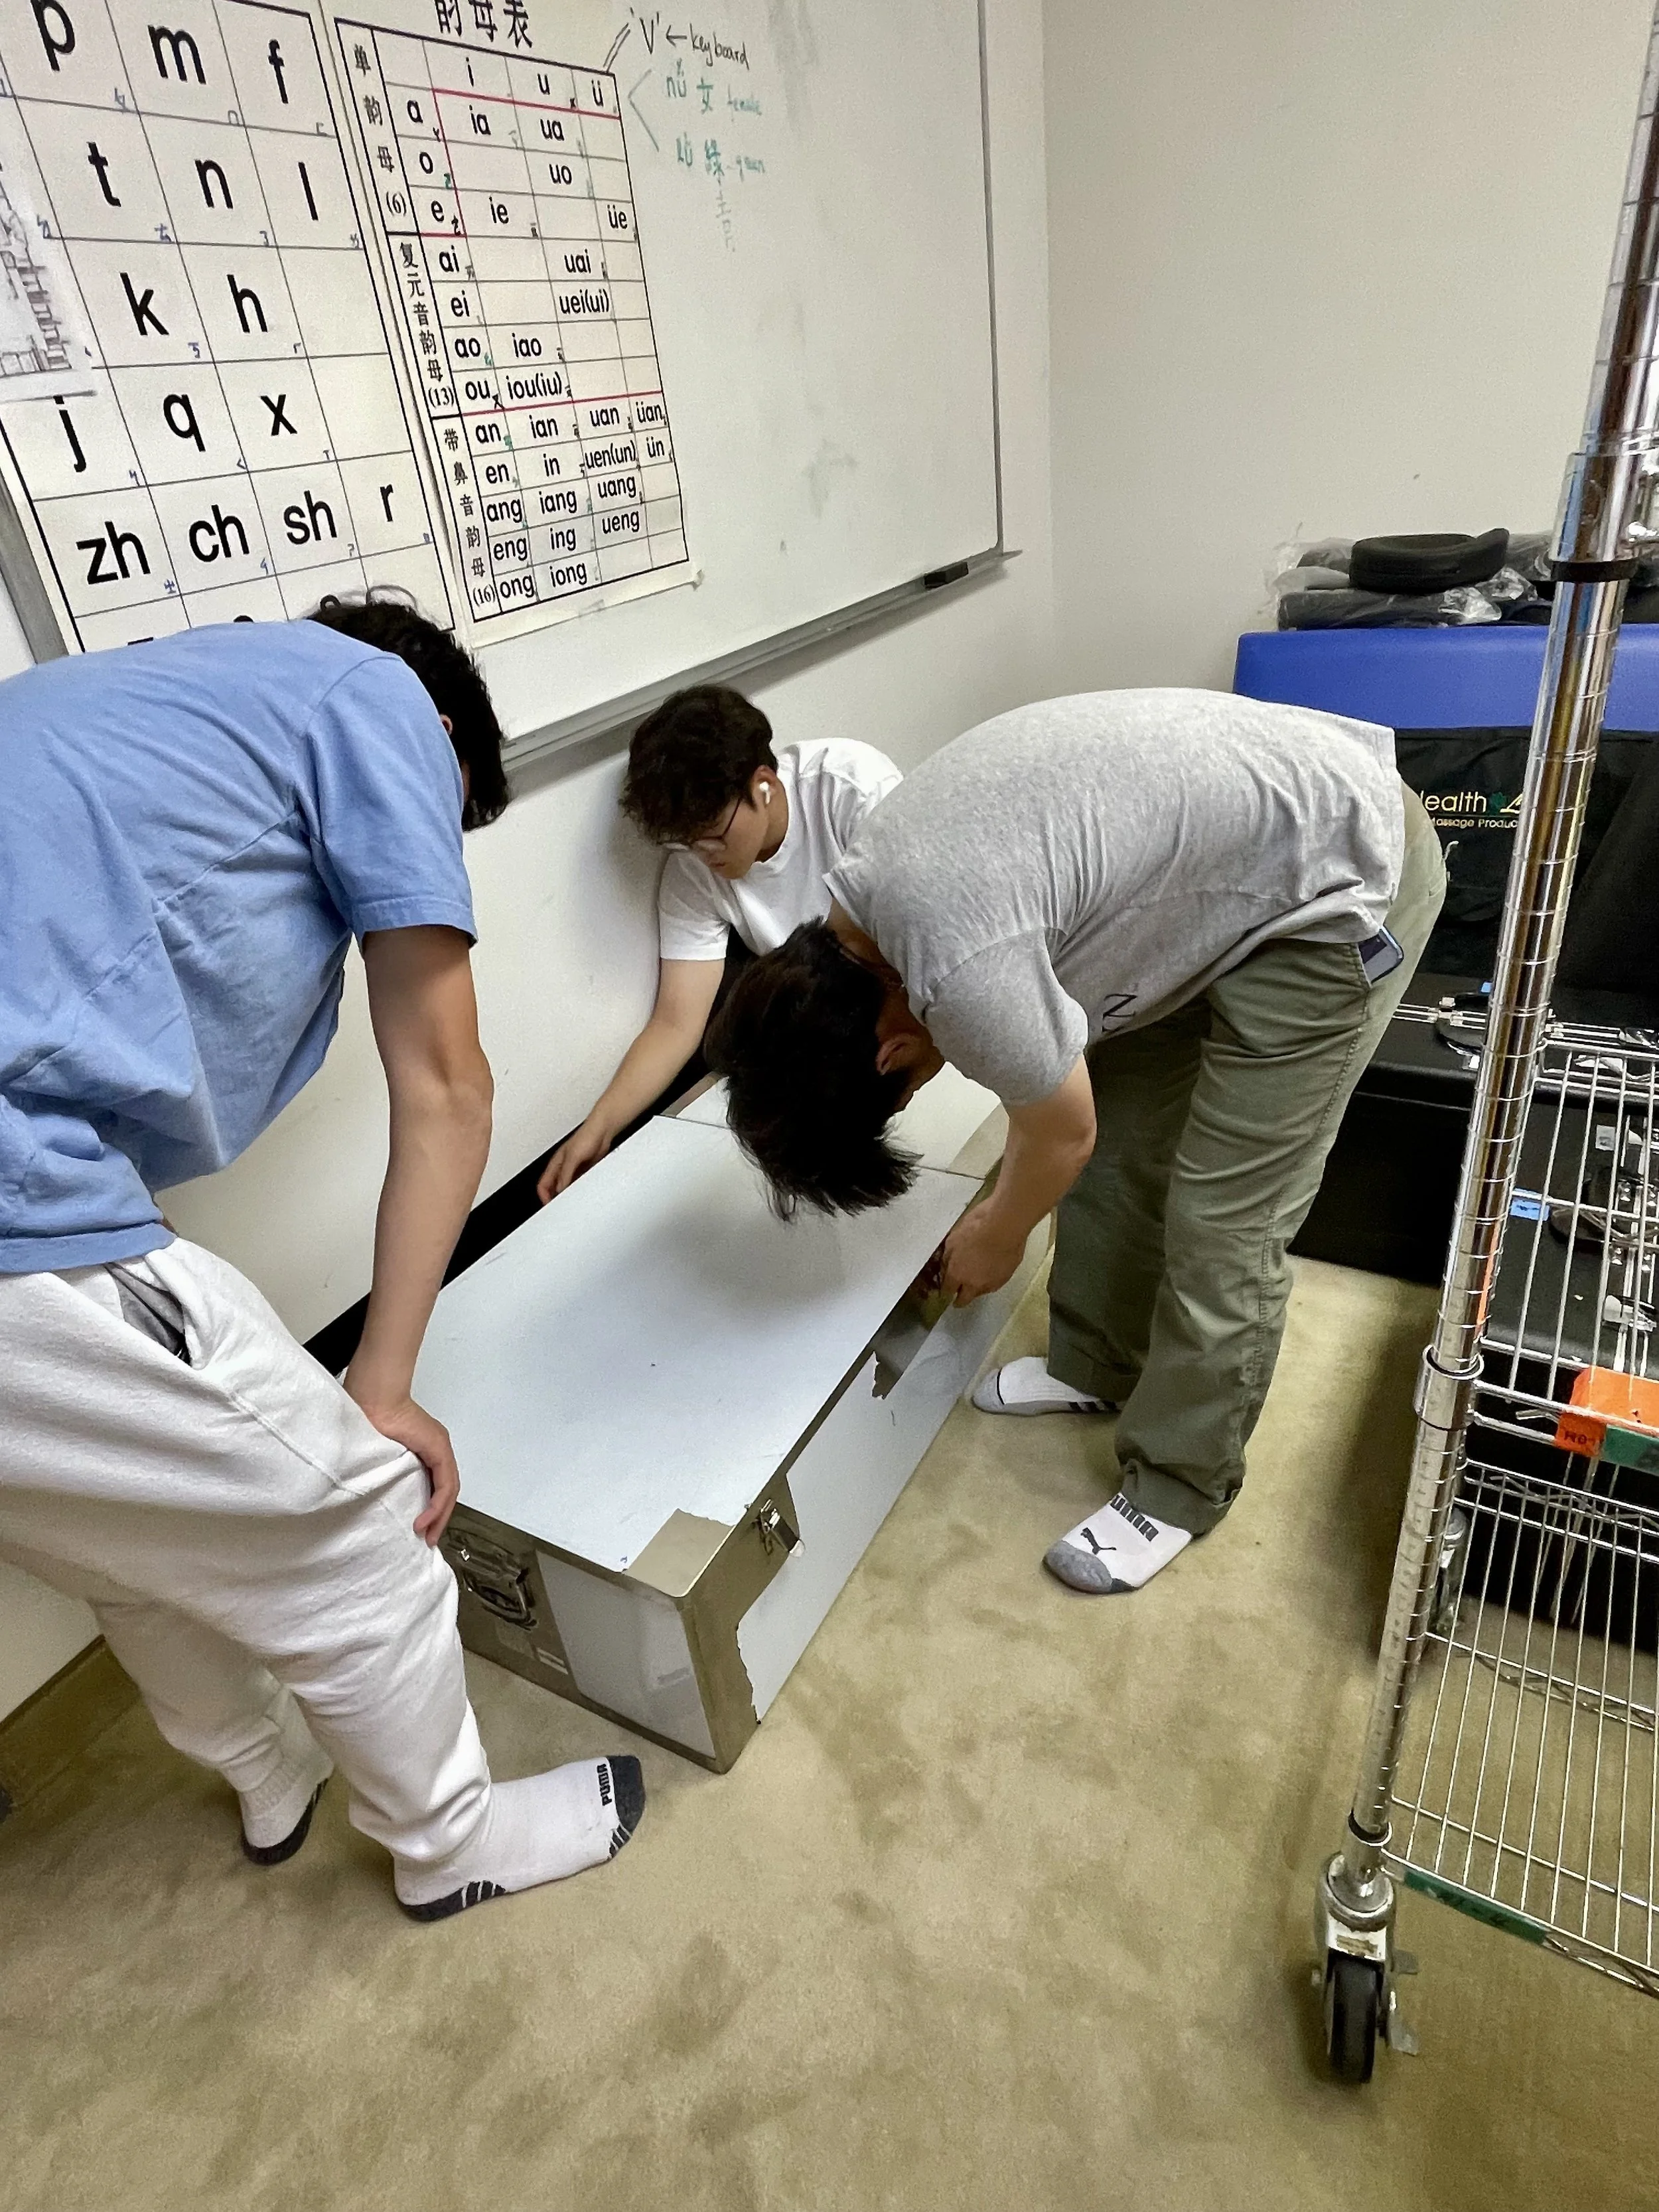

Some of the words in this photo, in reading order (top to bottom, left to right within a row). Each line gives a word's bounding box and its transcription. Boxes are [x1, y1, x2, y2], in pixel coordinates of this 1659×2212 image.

[30, 0, 76, 72] p
[147, 25, 206, 84] m
[268, 39, 289, 104] f
[689, 23, 750, 71] keyboard
[465, 57, 474, 87] i
[537, 74, 551, 96] u
[591, 80, 604, 107] ü
[407, 100, 423, 123] a
[469, 104, 492, 135] ia
[540, 119, 565, 141] ua
[88, 142, 121, 207] t
[194, 160, 234, 209] n
[419, 151, 433, 175] o
[549, 164, 572, 185] uo
[431, 200, 445, 222] e
[488, 196, 509, 224] ie
[607, 204, 628, 230] üe
[439, 244, 460, 272] ai
[564, 249, 591, 273] uai
[119, 272, 169, 336] k
[226, 274, 268, 333] h
[451, 289, 470, 317] ei
[559, 288, 609, 315] uei(ui)
[455, 338, 481, 358] ao
[512, 332, 542, 358] iao
[427, 386, 455, 409] (13)
[465, 380, 490, 401] ou
[506, 371, 562, 400] iou(iu)
[52, 396, 87, 473] j
[163, 394, 206, 452] q
[260, 394, 297, 436] x
[475, 423, 502, 443] an
[529, 415, 559, 439] ian
[589, 407, 620, 427] uan
[635, 401, 662, 423] üan
[486, 464, 510, 484] en
[543, 453, 561, 477] in
[584, 439, 636, 469] uen(un)
[646, 436, 665, 458] ün
[486, 498, 522, 524] ang
[539, 490, 577, 514] iang
[597, 476, 636, 498] uang
[76, 521, 151, 585] zh
[188, 504, 250, 562] ch
[283, 490, 337, 545] sh
[380, 484, 394, 522] r
[493, 538, 528, 561] eng
[549, 528, 576, 552] ing
[602, 509, 640, 534] ueng
[500, 575, 535, 599] ong
[549, 563, 587, 587] iong
[1420, 790, 1486, 812] ealth
[1478, 818, 1518, 829] Produc
[597, 1763, 613, 1806] PUMA
